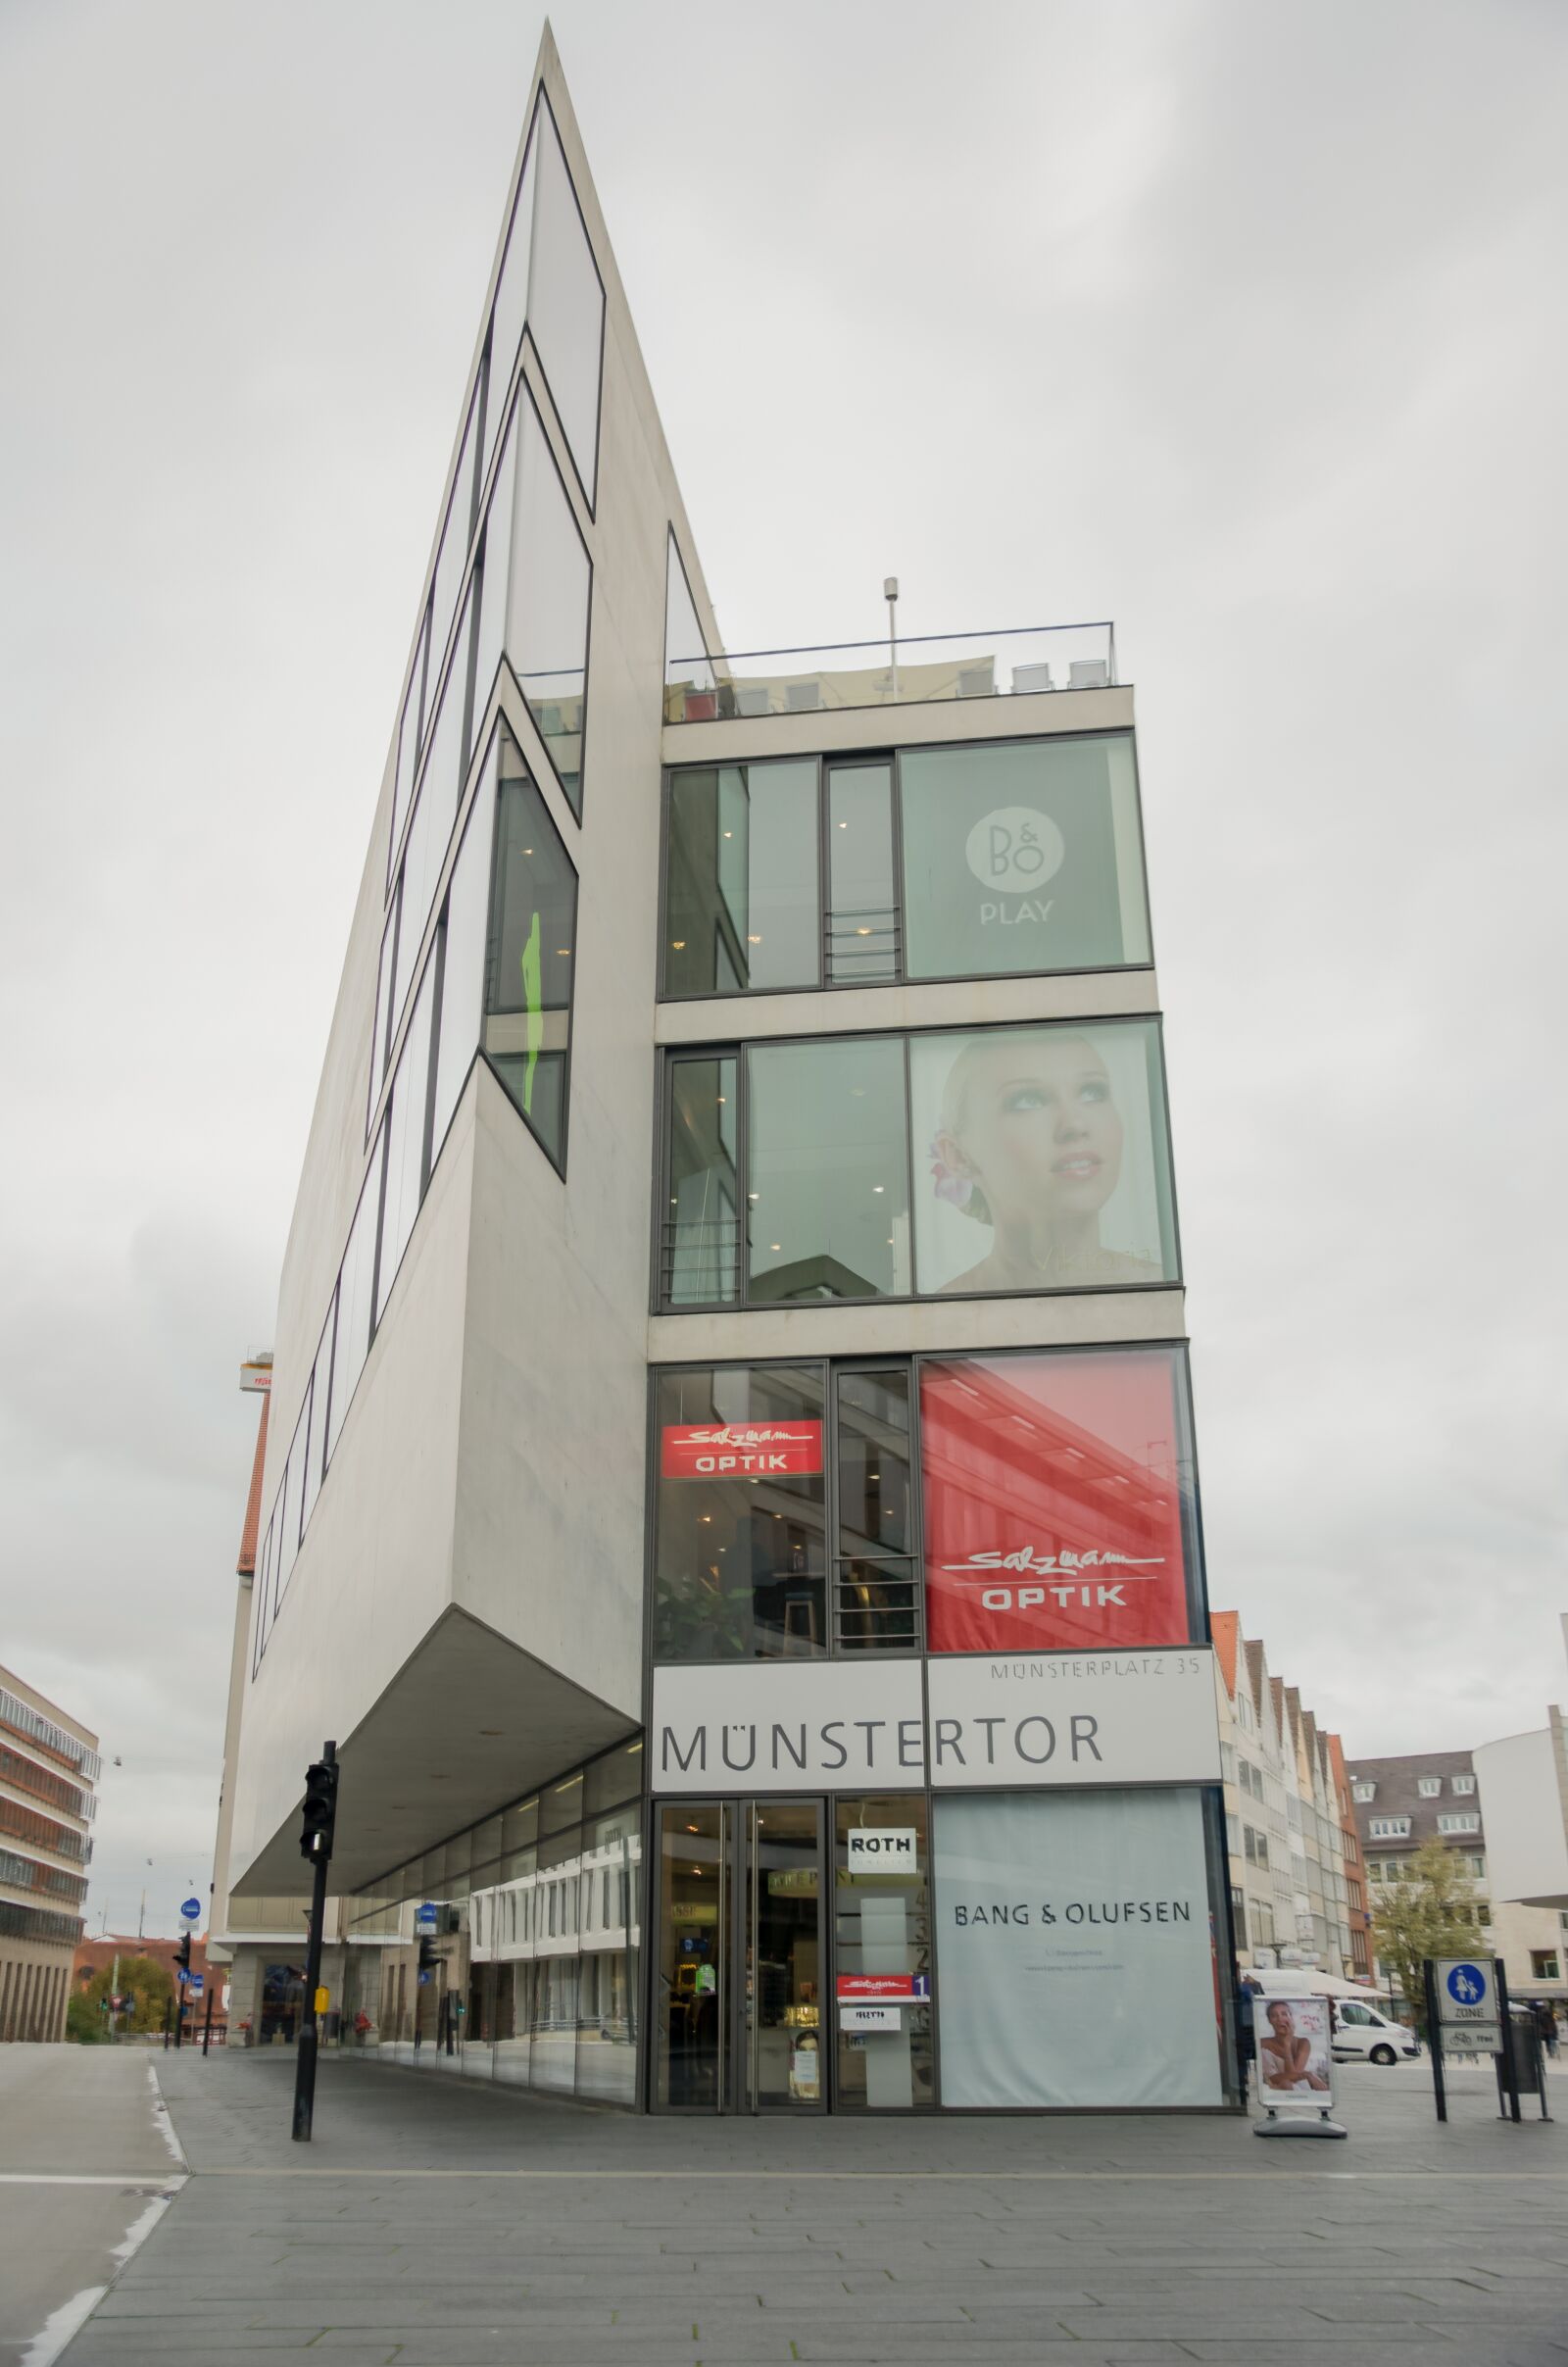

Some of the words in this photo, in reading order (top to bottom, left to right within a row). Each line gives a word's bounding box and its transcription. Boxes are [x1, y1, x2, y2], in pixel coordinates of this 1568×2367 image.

[980, 899, 1054, 925] PLAY
[695, 1455, 787, 1472] OPTIK
[982, 1584, 1127, 1610] OPTIK
[991, 1658, 1164, 1680] MÜNSTERPLATZ
[1175, 1657, 1200, 1675] 35
[662, 1715, 1103, 1772] MÜNSTERTOR
[852, 1838, 910, 1853] ROTH
[955, 1904, 1029, 1926] BANG
[1042, 1904, 1056, 1924] &
[1065, 1901, 1191, 1923] OLUFSEN
[914, 1976, 925, 1996] 1
[1455, 2007, 1485, 2018] ZONE
